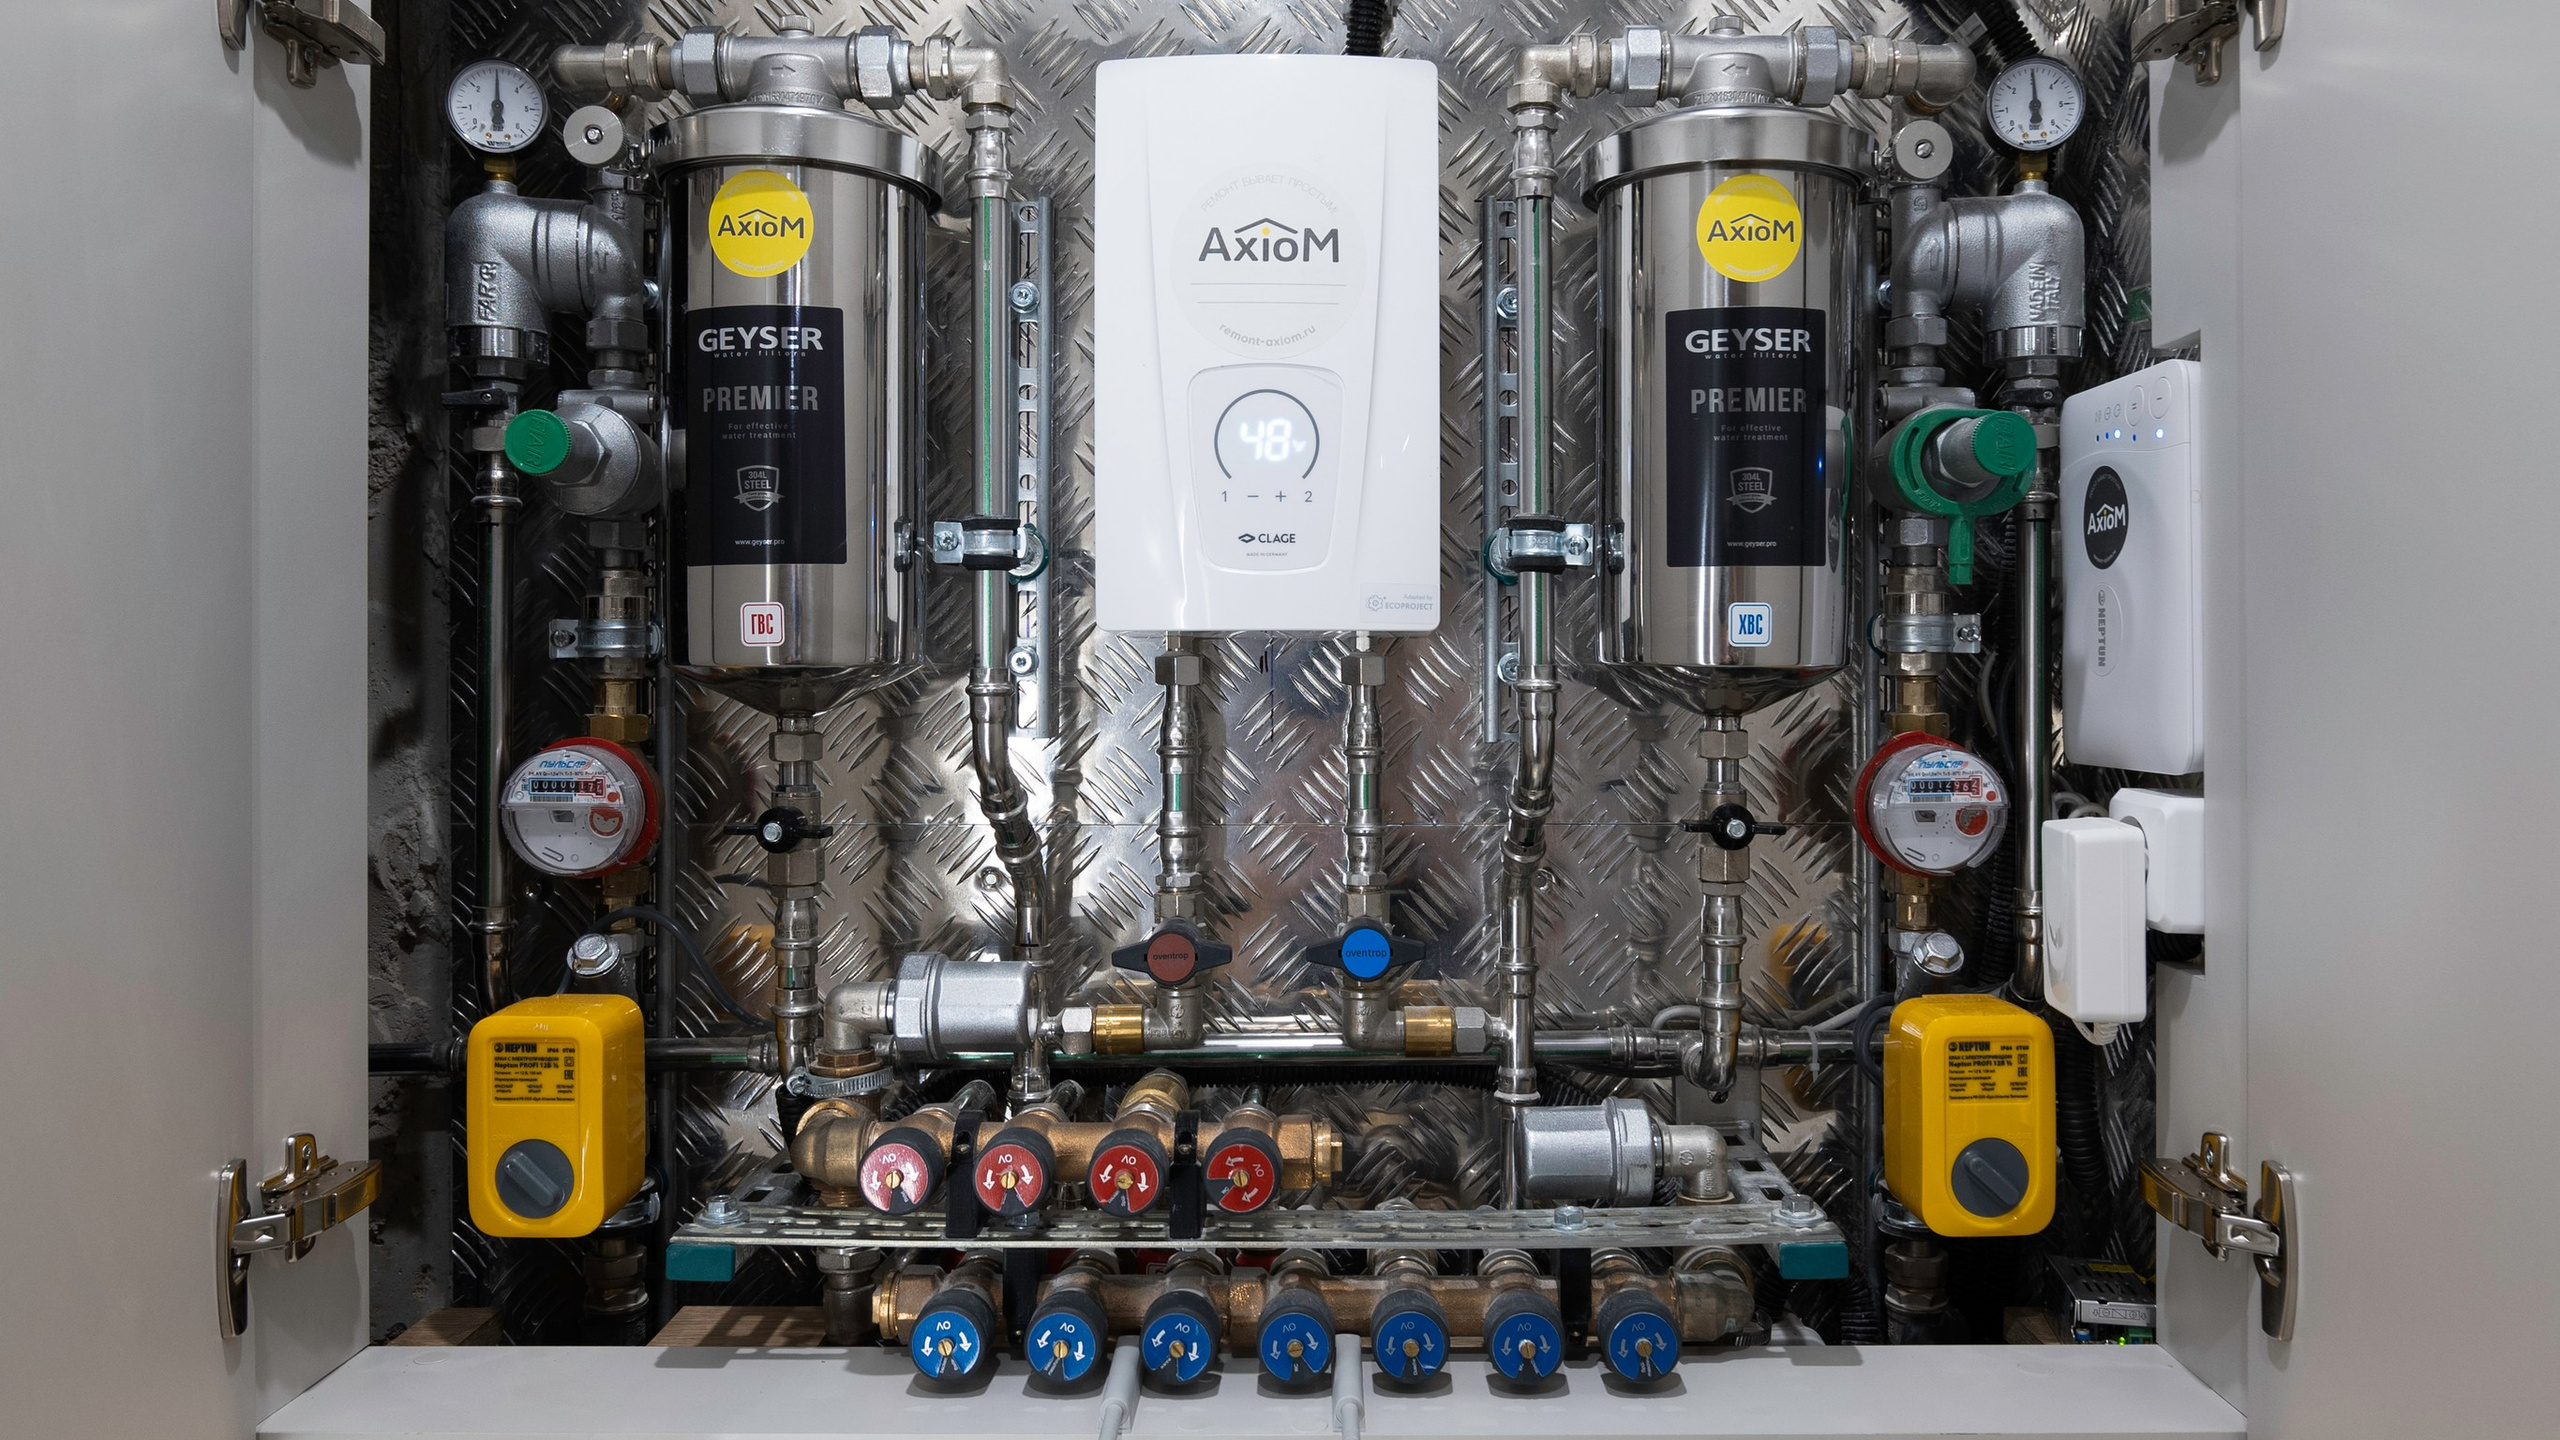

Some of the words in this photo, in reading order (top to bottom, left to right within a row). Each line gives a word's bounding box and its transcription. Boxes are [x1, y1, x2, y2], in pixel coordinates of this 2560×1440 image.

[1201, 179, 1239, 213] РЕМОНТ
[1242, 174, 1285, 187] БЫВАЕТ
[717, 213, 804, 239] AxioM
[1706, 218, 1795, 243] AxioM
[1199, 226, 1340, 263] AxioM
[698, 326, 824, 352] GEYSER
[1219, 323, 1316, 347] remont-axiom.ru
[1685, 328, 1811, 353] GEYSER
[714, 350, 749, 358] water
[1704, 352, 1743, 360] water
[1753, 351, 1797, 359] filters
[703, 385, 819, 413] PREMIER
[1690, 387, 1807, 414] PREMIER
[728, 422, 742, 430] For
[746, 422, 789, 430] effective
[1721, 424, 1736, 432] For
[1740, 424, 1782, 432] effective
[722, 432, 745, 440] water
[1240, 417, 1292, 462] 48
[748, 470, 768, 479] 304L
[1741, 472, 1761, 481] 304L
[744, 479, 772, 489] STEEL
[1737, 481, 1766, 491] STEEL
[1221, 490, 1228, 502] 1
[1304, 490, 1313, 502] 2
[2086, 503, 2126, 535] AxioM
[735, 538, 785, 547] www.geyser.pro
[1258, 533, 1296, 544] CLAGE
[1726, 540, 1777, 548] www.geyser.pro
[1385, 602, 1433, 610] ECOPROJECT
[751, 613, 774, 635] ГВС
[1738, 613, 1763, 635] ХВС
[2097, 607, 2106, 668] NEPTUN
[1152, 951, 1189, 962] oventrop
[1345, 947, 1387, 960] oventrop
[505, 1042, 537, 1053] NEPTUN
